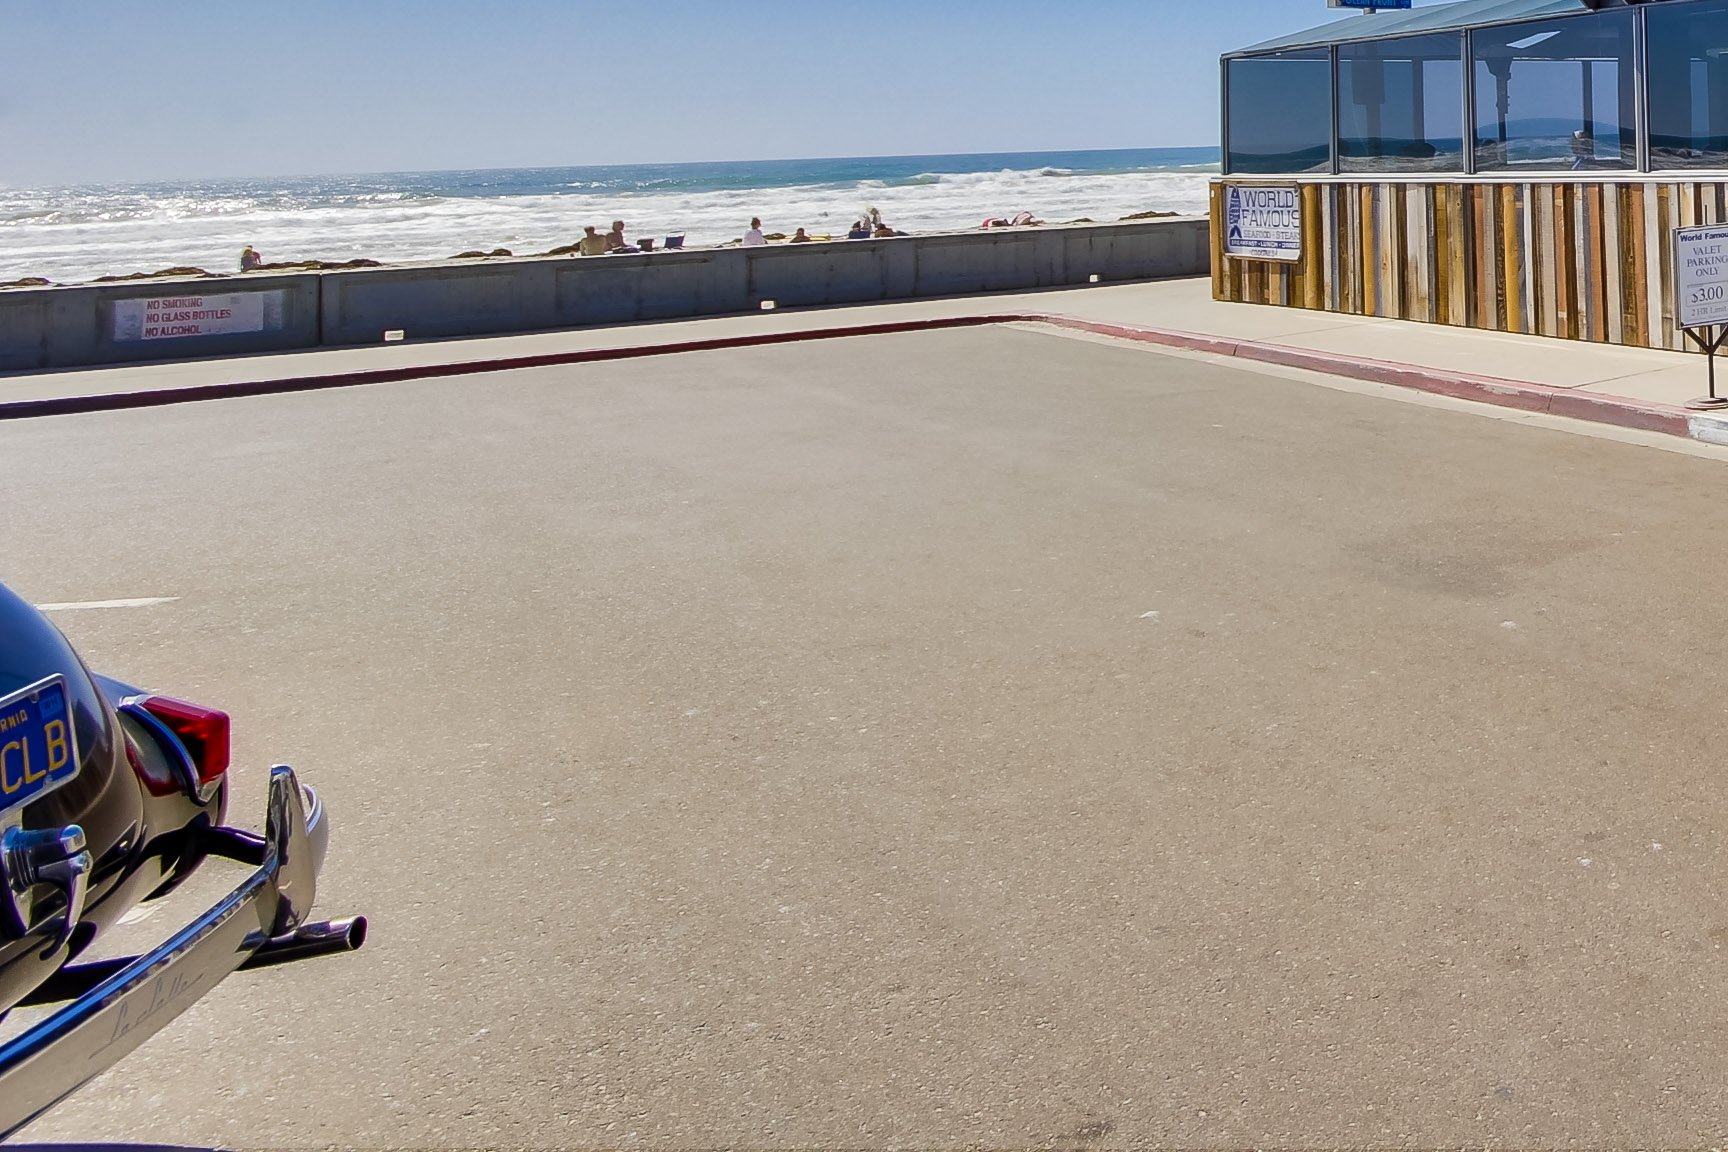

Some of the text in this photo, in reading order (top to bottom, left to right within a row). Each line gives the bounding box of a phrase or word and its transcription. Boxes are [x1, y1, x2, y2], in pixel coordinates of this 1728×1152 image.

[1243, 190, 1294, 208] WORLD
[1241, 209, 1300, 228] FAMOUS
[1275, 230, 1300, 240] STEAK
[1680, 234, 1702, 242] World
[1692, 245, 1722, 256] VALET
[1687, 255, 1728, 267] PARKING
[1695, 267, 1720, 278] ONLY
[1691, 286, 1724, 303] $3.00
[146, 298, 203, 310] NO SMOKING
[146, 309, 232, 323] NO GLASS BOTTLES
[145, 327, 158, 337] NO
[160, 325, 202, 336] ALCOHOL
